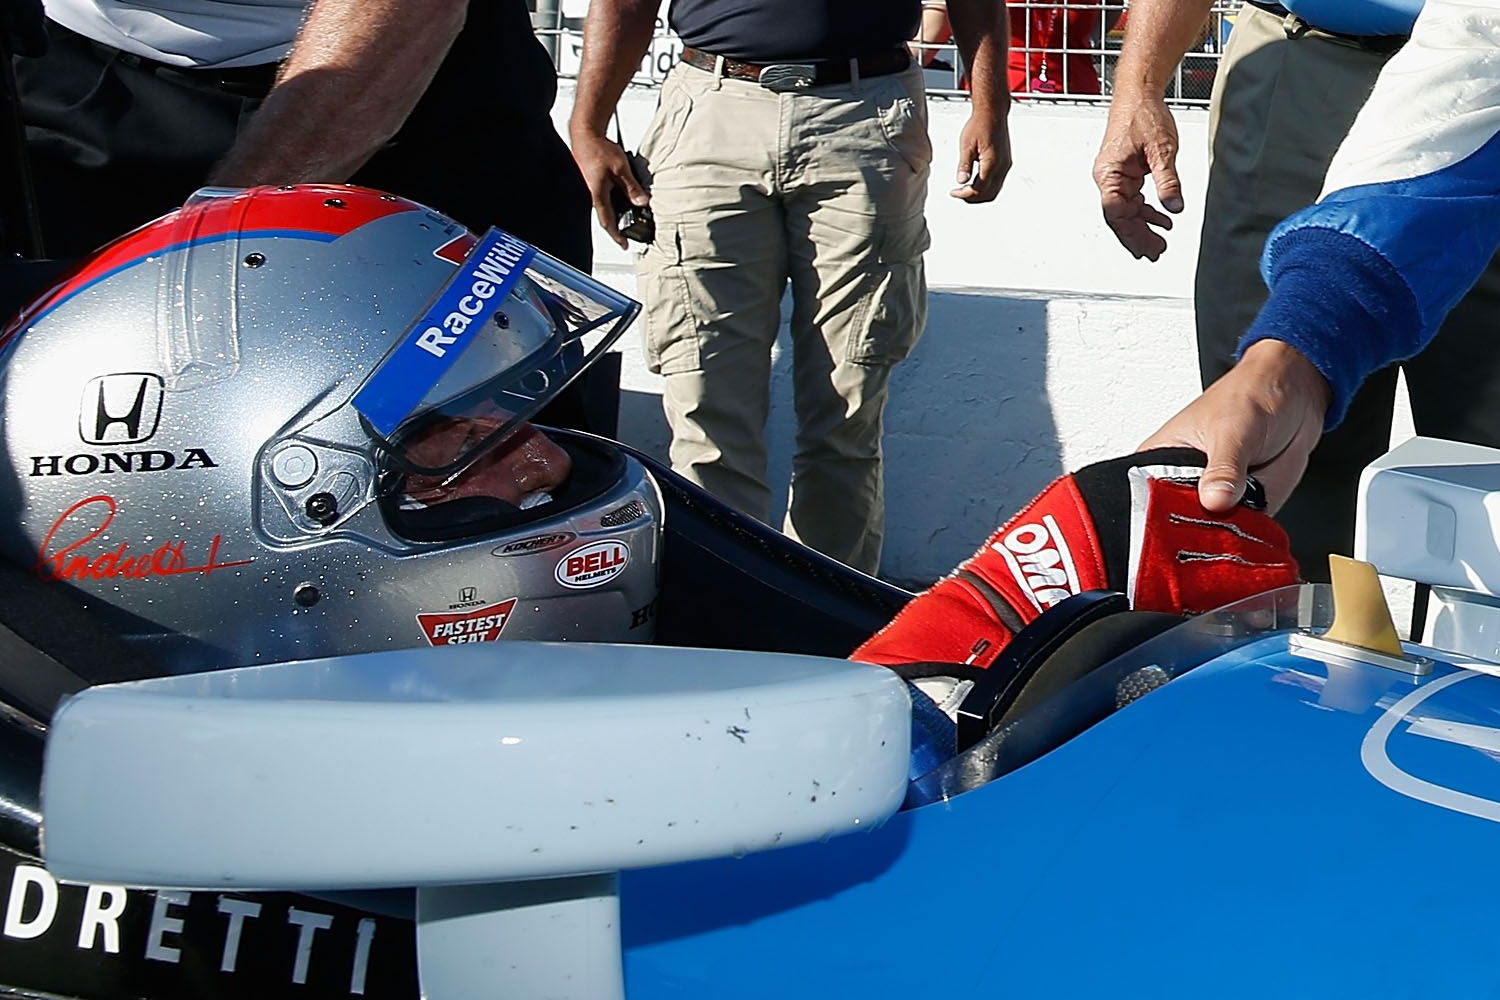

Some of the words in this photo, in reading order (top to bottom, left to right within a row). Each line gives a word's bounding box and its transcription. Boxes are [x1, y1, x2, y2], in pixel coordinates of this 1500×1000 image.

[29, 447, 220, 477] HONDA
[565, 547, 626, 578] BELL
[574, 567, 617, 583] HELMETS
[448, 600, 486, 610] HONDA
[431, 613, 506, 639] FASTEST
